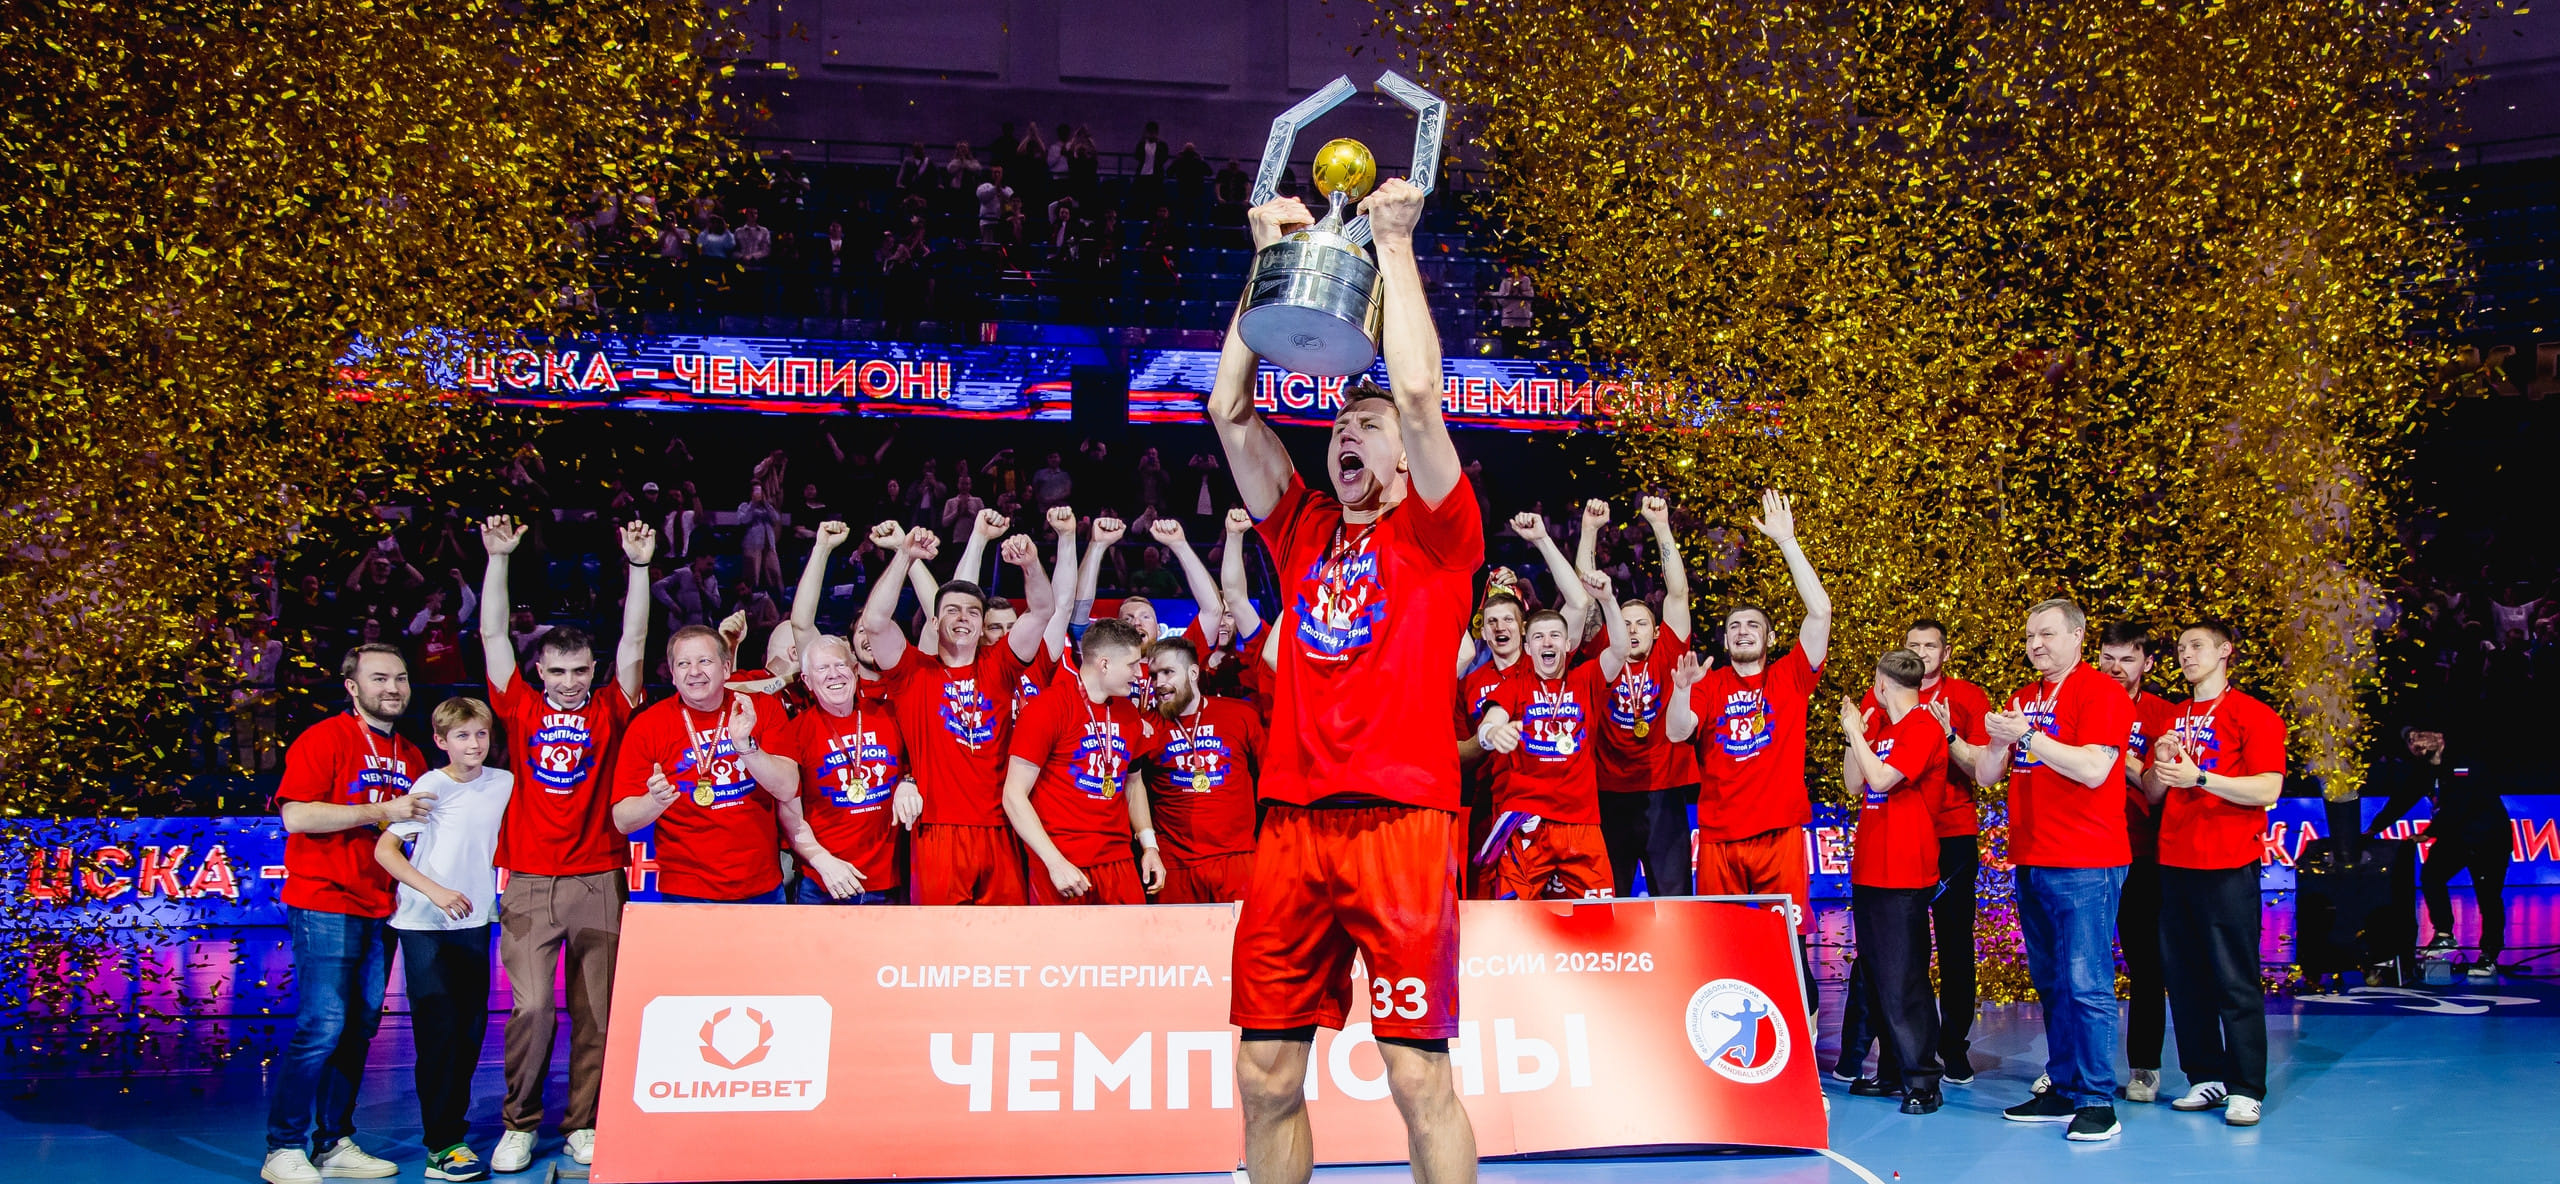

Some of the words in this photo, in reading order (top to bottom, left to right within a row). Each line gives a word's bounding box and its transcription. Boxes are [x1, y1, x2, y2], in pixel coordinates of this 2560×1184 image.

[465, 348, 620, 392] ЦСКА
[673, 353, 951, 400] ЧЕМПИОН!
[1253, 371, 1373, 412] ЦСК
[1338, 625, 1369, 648] Х-ТРИК
[540, 729, 590, 742] ЧЕМПИОН
[542, 713, 586, 732] ЦСКА
[1082, 737, 1125, 751] ЧЕМПОН
[28, 845, 240, 899] ЦСКА
[876, 965, 1031, 988] OLIMPBET
[1039, 965, 1214, 988] СУПЕРЛИГА
[1459, 953, 1546, 978] ССИИ
[1554, 951, 1655, 973] 2025/26
[1371, 976, 1428, 1019] 33
[929, 1012, 1593, 1112] ЧЕМПОНЫ
[1717, 1061, 1755, 1078] HANDBALL
[648, 1079, 813, 1099] OLIMPBET
